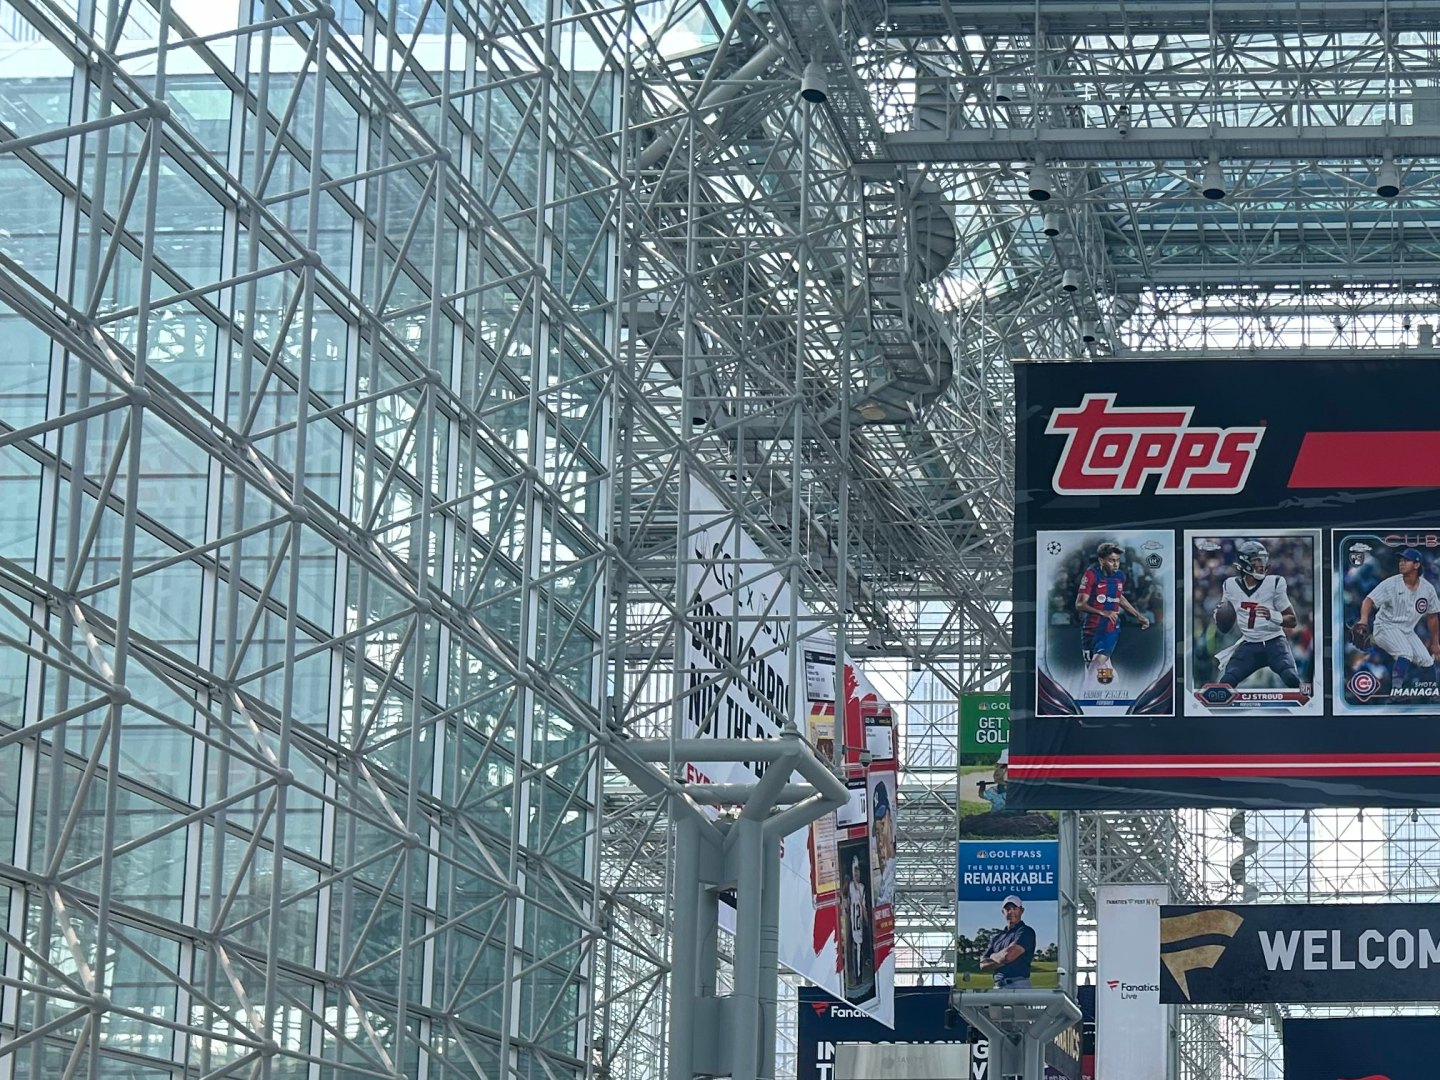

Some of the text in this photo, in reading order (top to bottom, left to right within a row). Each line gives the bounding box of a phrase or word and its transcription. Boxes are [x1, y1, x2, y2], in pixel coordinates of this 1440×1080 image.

[1241, 602, 1258, 629] 7
[1390, 687, 1440, 697] IMANAGA
[979, 717, 1002, 729] GET
[989, 850, 1042, 858] GOLFPASS
[964, 872, 1054, 885] REMARKABLE
[1121, 983, 1160, 992] Fanatics
